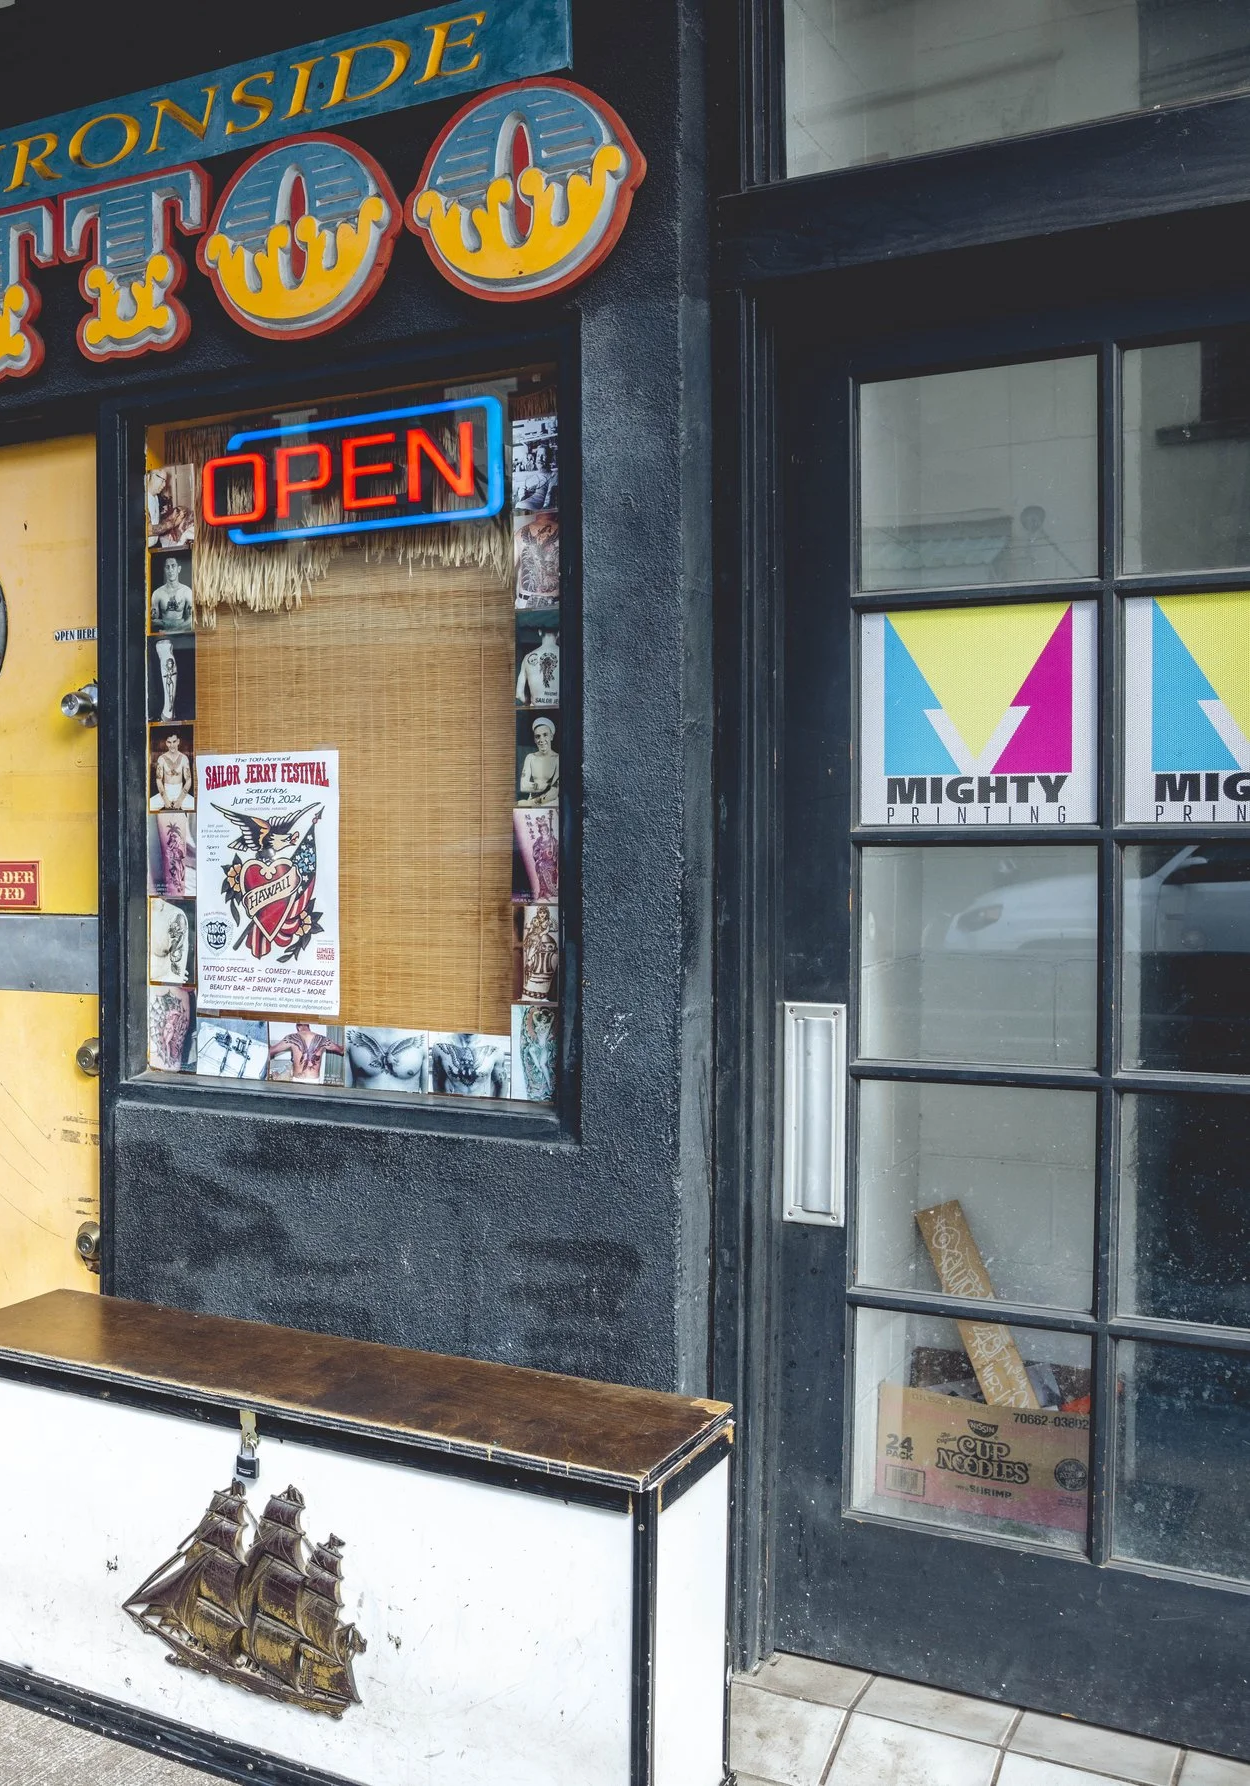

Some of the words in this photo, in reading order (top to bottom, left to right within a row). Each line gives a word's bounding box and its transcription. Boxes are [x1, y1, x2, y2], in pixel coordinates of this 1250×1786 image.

[202, 421, 475, 527] OPEN
[55, 630, 75, 642] OPEN
[205, 765, 241, 791] SAILOR
[244, 763, 277, 784] JERRY
[281, 761, 330, 787] FESTIVAL
[245, 787, 288, 795] Saturday,
[886, 775, 1068, 804] MIGHTY
[231, 797, 253, 806] June
[255, 796, 276, 805] 15th,
[278, 795, 302, 804] 2024
[887, 806, 1066, 824] PRINTING
[1155, 804, 1247, 823] PRIN
[249, 875, 291, 911] HAWAII
[226, 966, 255, 974] SPECIALS
[297, 969, 335, 977] BURLESQUE
[252, 985, 272, 993] DRINK
[273, 986, 301, 994] SPECIALS
[303, 978, 334, 986] PAGEANT
[970, 1422, 995, 1433] NISSIN
[886, 1433, 914, 1451] 24
[957, 1435, 1010, 1462] CUP
[885, 1449, 914, 1462] PACK
[936, 1447, 1029, 1485] NOODLES
[969, 1484, 1012, 1499] SHRIMP
